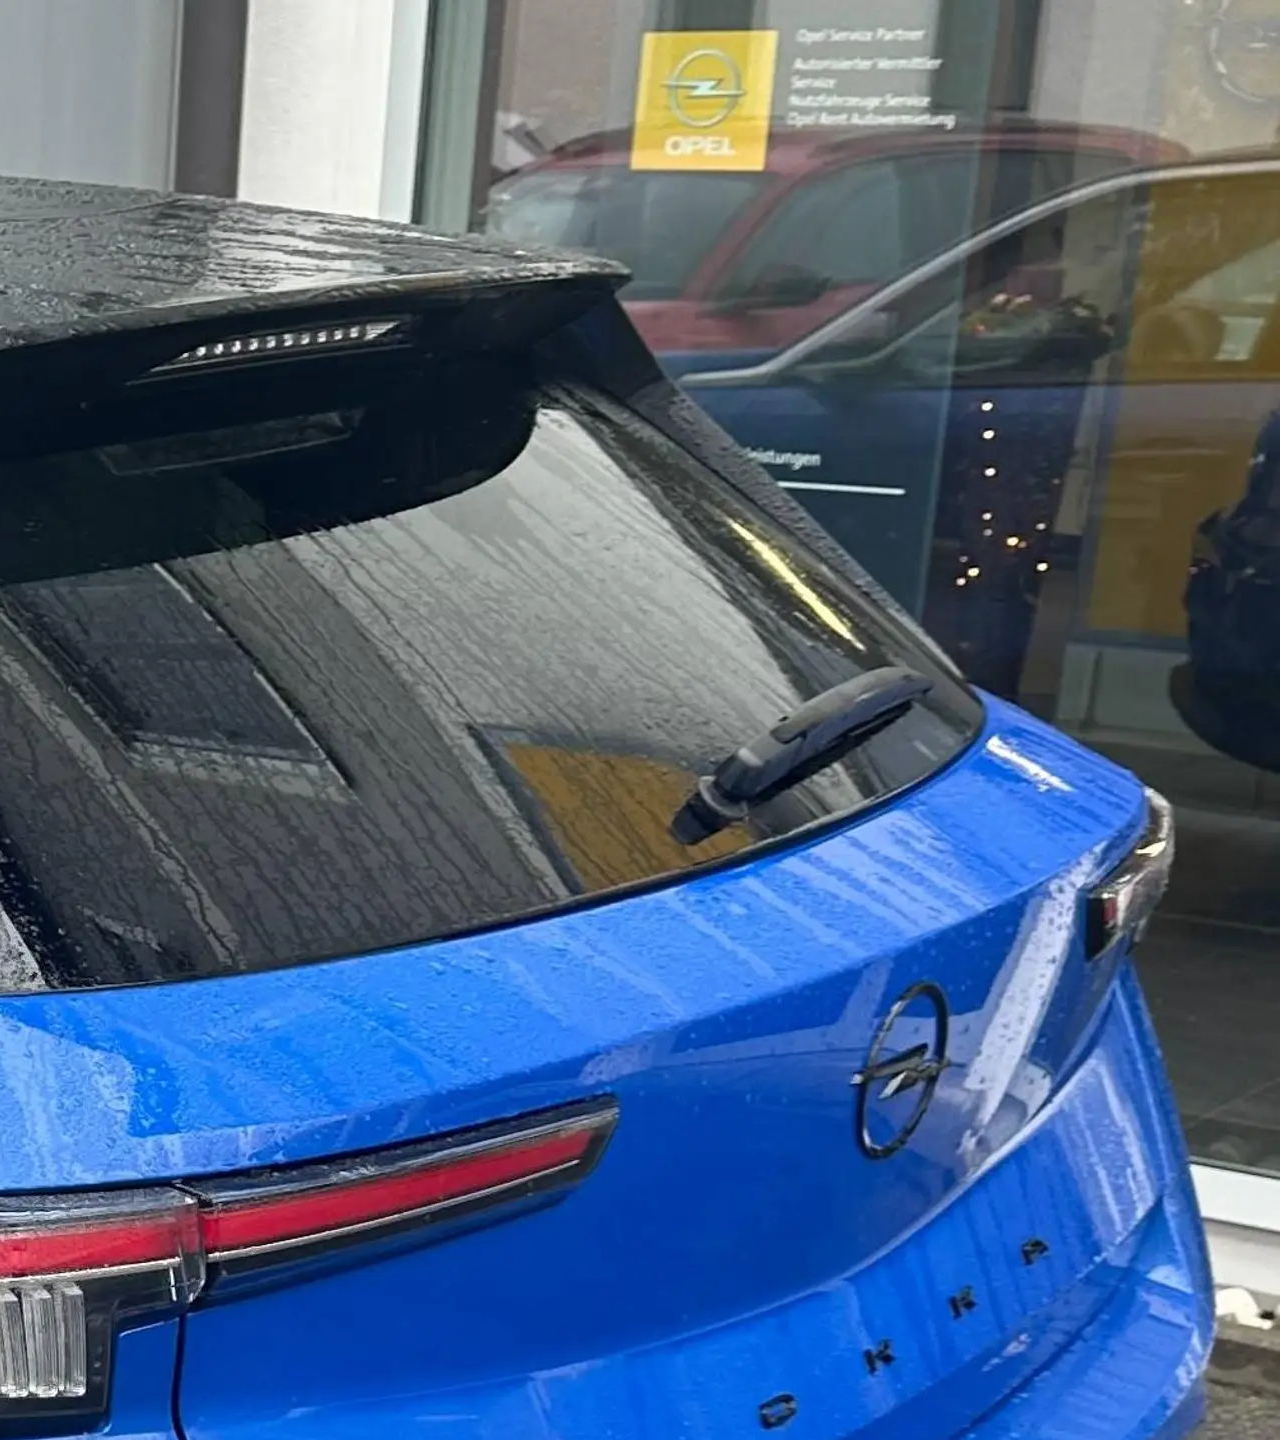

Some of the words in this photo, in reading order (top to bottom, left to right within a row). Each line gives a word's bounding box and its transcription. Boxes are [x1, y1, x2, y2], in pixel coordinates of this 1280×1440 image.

[796, 29, 827, 45] Opel
[828, 28, 874, 42] Service
[876, 27, 927, 42] Partner
[664, 136, 738, 157] OPEL
